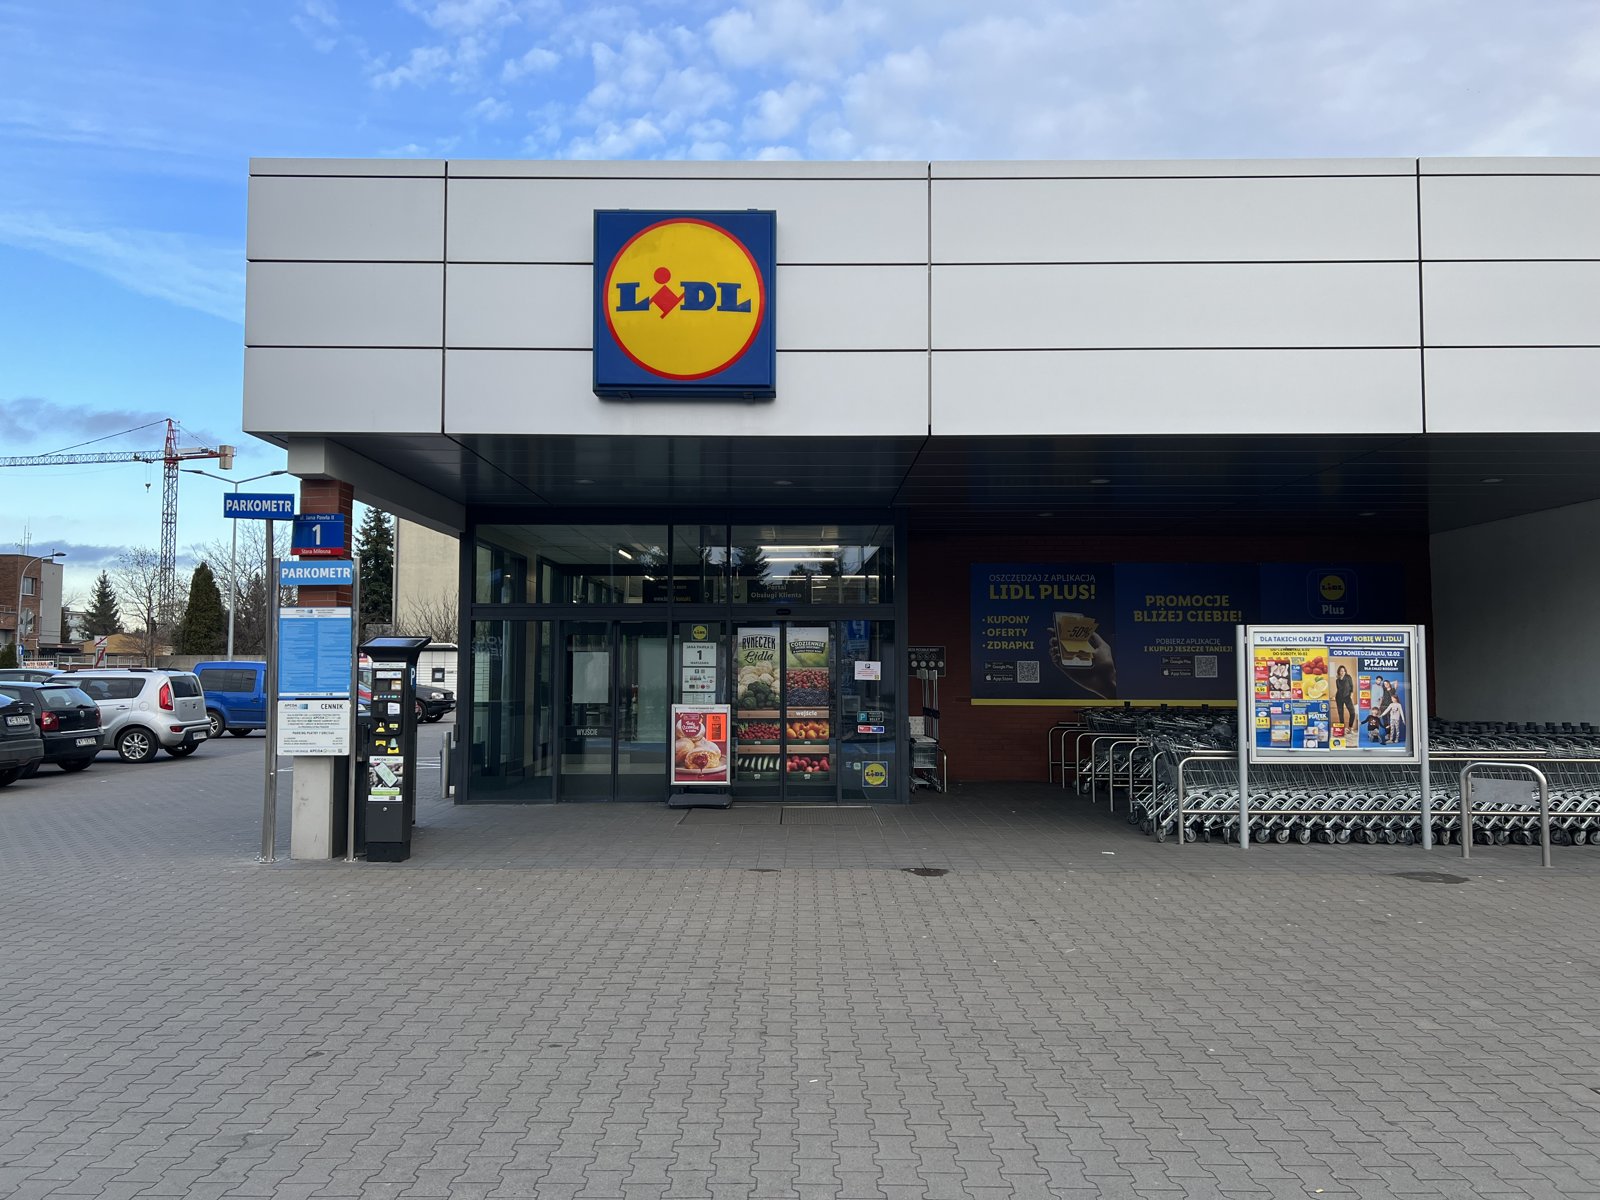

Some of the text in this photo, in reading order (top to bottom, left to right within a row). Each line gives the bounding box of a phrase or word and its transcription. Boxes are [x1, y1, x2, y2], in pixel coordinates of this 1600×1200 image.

[616, 267, 751, 319] LIDL
[226, 500, 291, 512] PARKOMETR
[312, 524, 320, 545] 1
[281, 568, 351, 578] PARKOMETR
[989, 574, 1096, 583] OSZCZĘDZAJ Z APLIKACJĄ
[989, 584, 1096, 600] LIDL PLUS!
[1145, 595, 1230, 607] PROMOCJE
[1321, 604, 1345, 615] Plus
[987, 616, 1030, 624] KUPONY
[1134, 608, 1242, 622] BLIŻEJ CIEBIE!
[987, 628, 1028, 637] OFERTY
[1067, 625, 1092, 638] -50%
[742, 635, 776, 650] RYNECZEK
[987, 641, 1035, 649] ZDRAPKI
[1186, 638, 1221, 646] APLIKACJĘ
[697, 650, 702, 660] 1
[1364, 658, 1399, 667] PIŻAMY
[576, 727, 598, 736] WYJŚCIE
